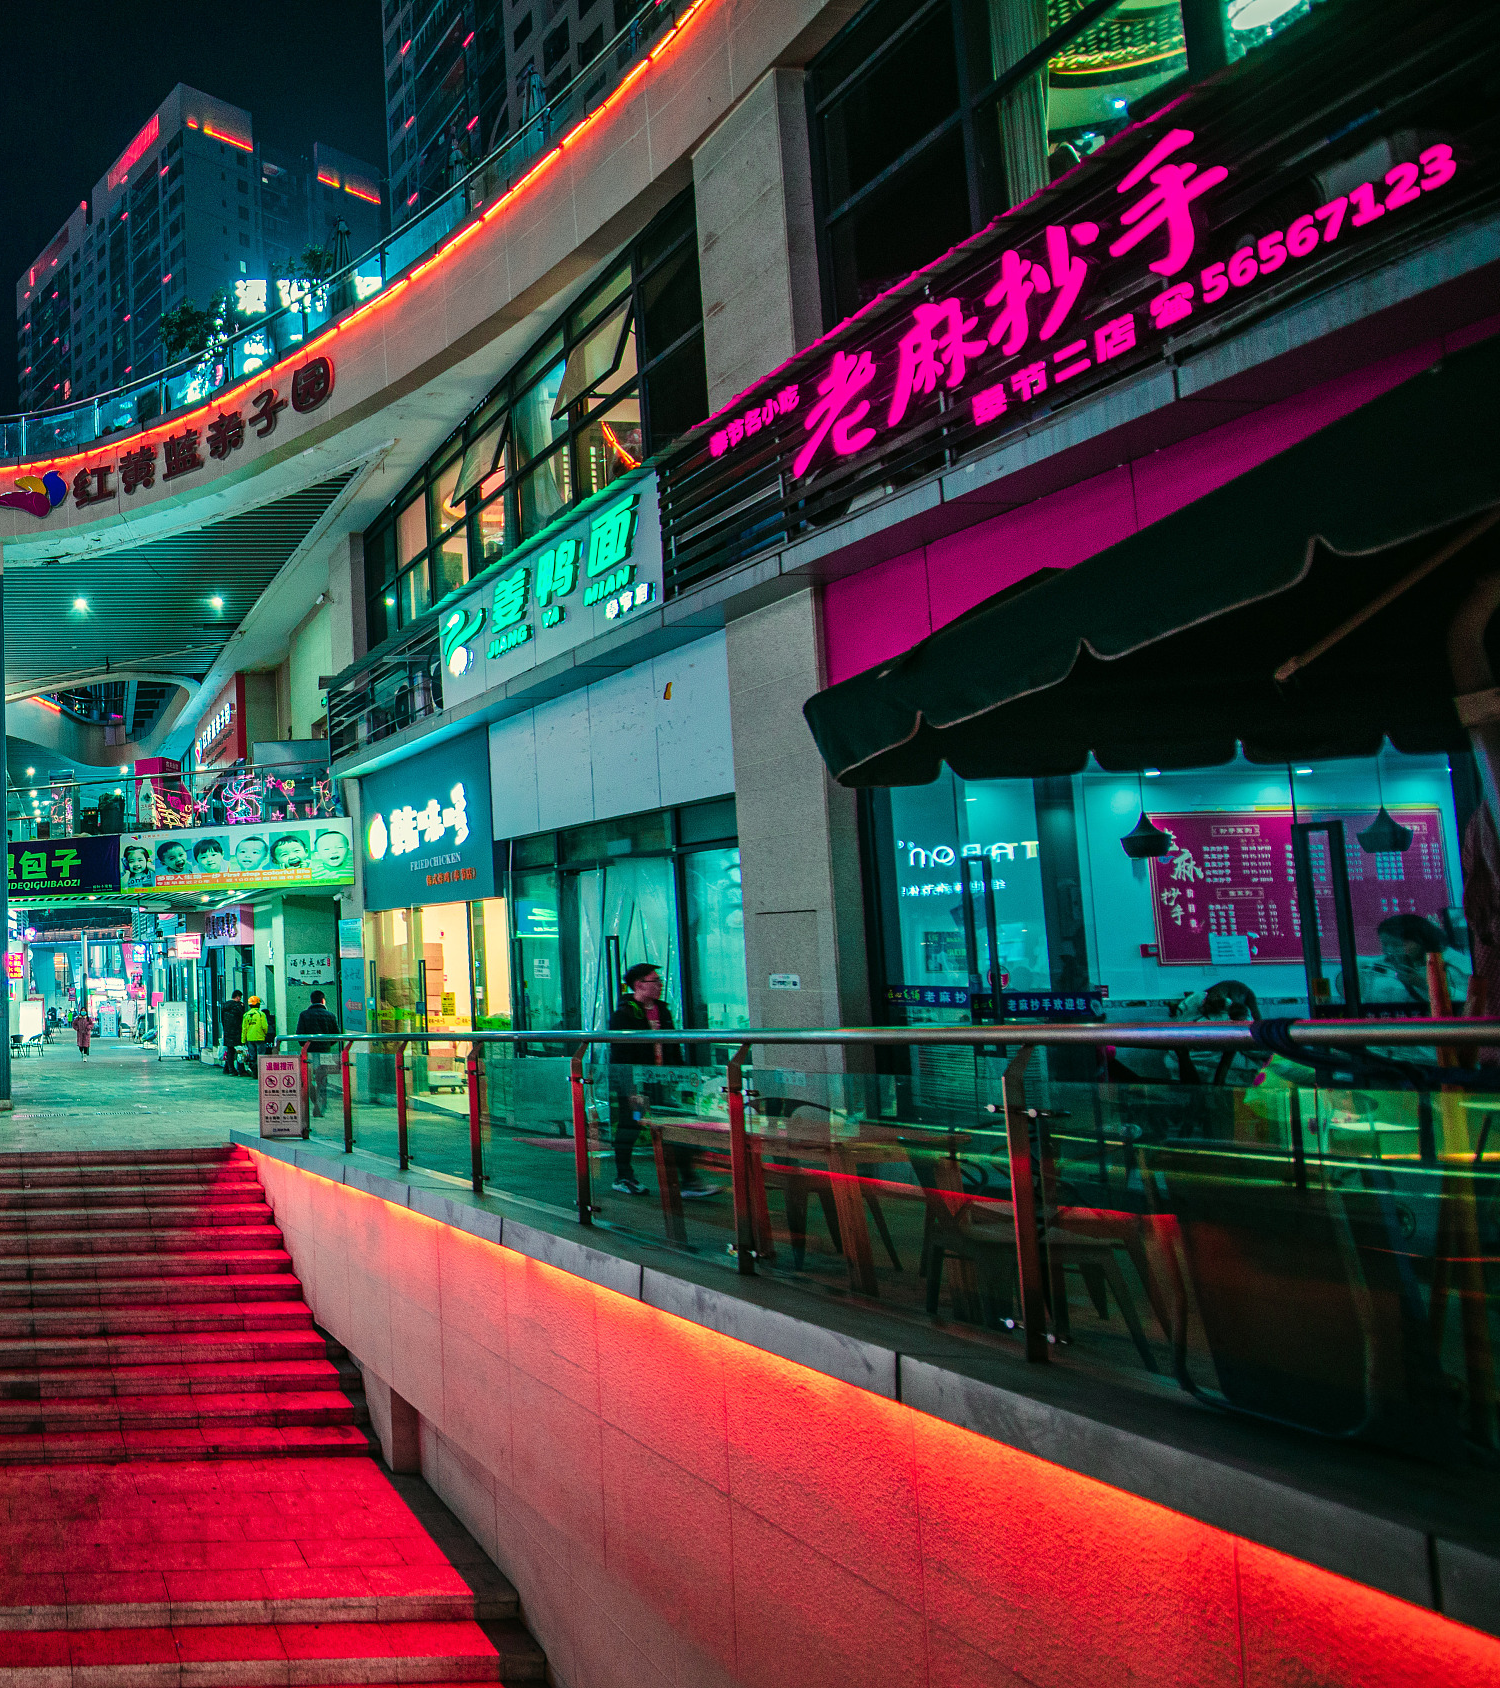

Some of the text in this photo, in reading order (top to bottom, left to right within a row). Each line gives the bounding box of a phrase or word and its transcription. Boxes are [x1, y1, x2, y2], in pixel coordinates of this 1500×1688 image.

[1203, 143, 1457, 304] 56567123
[793, 128, 1228, 479] 老麻抄手
[73, 356, 334, 509] 红黄蓝亲子园
[486, 625, 532, 660] JIANG
[584, 565, 637, 607] MIAN
